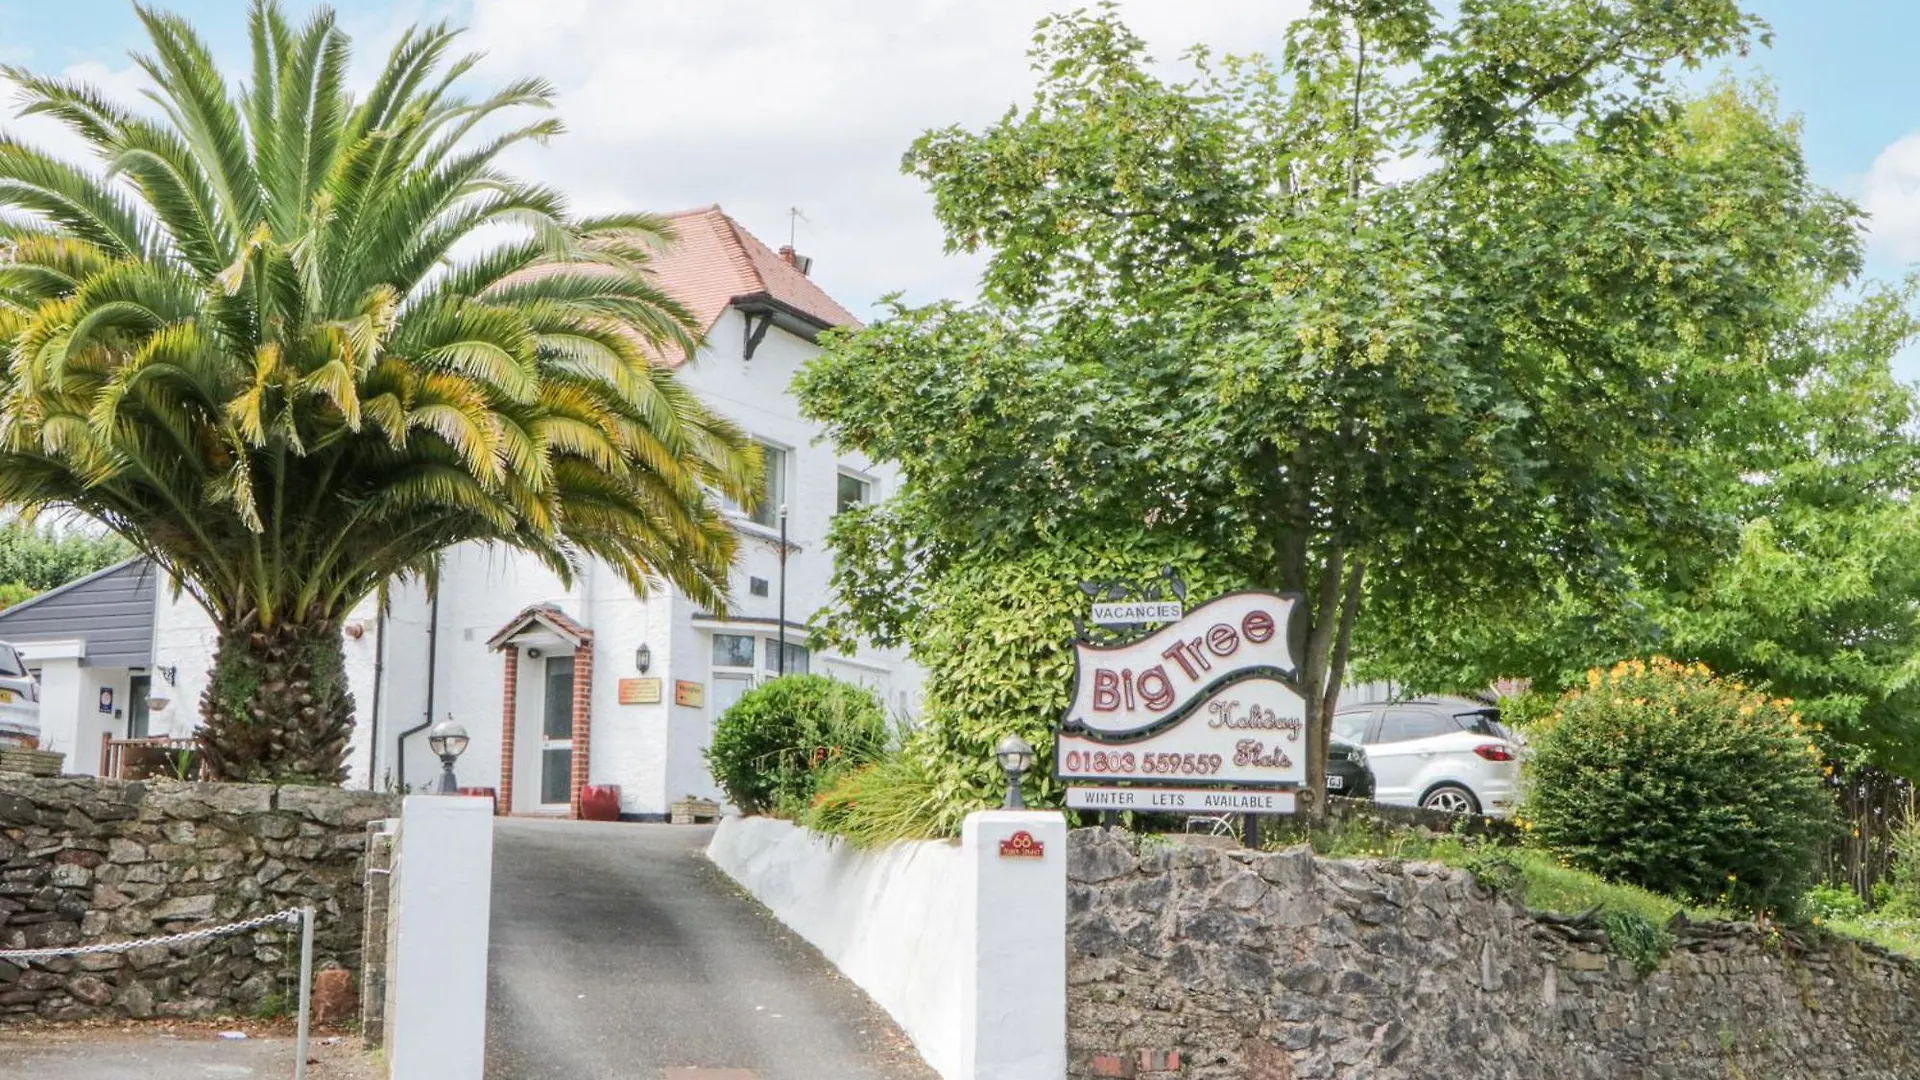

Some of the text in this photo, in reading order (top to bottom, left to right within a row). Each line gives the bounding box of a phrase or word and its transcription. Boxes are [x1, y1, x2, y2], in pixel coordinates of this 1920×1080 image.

[1094, 605, 1181, 619] VACANCIES
[1093, 609, 1275, 712] Big Tree
[1208, 700, 1303, 741] Holiday
[1066, 750, 1222, 775] 01803 559559
[1233, 739, 1293, 768] Flats
[1085, 791, 1274, 808] WINTER LETS AVAILABLE
